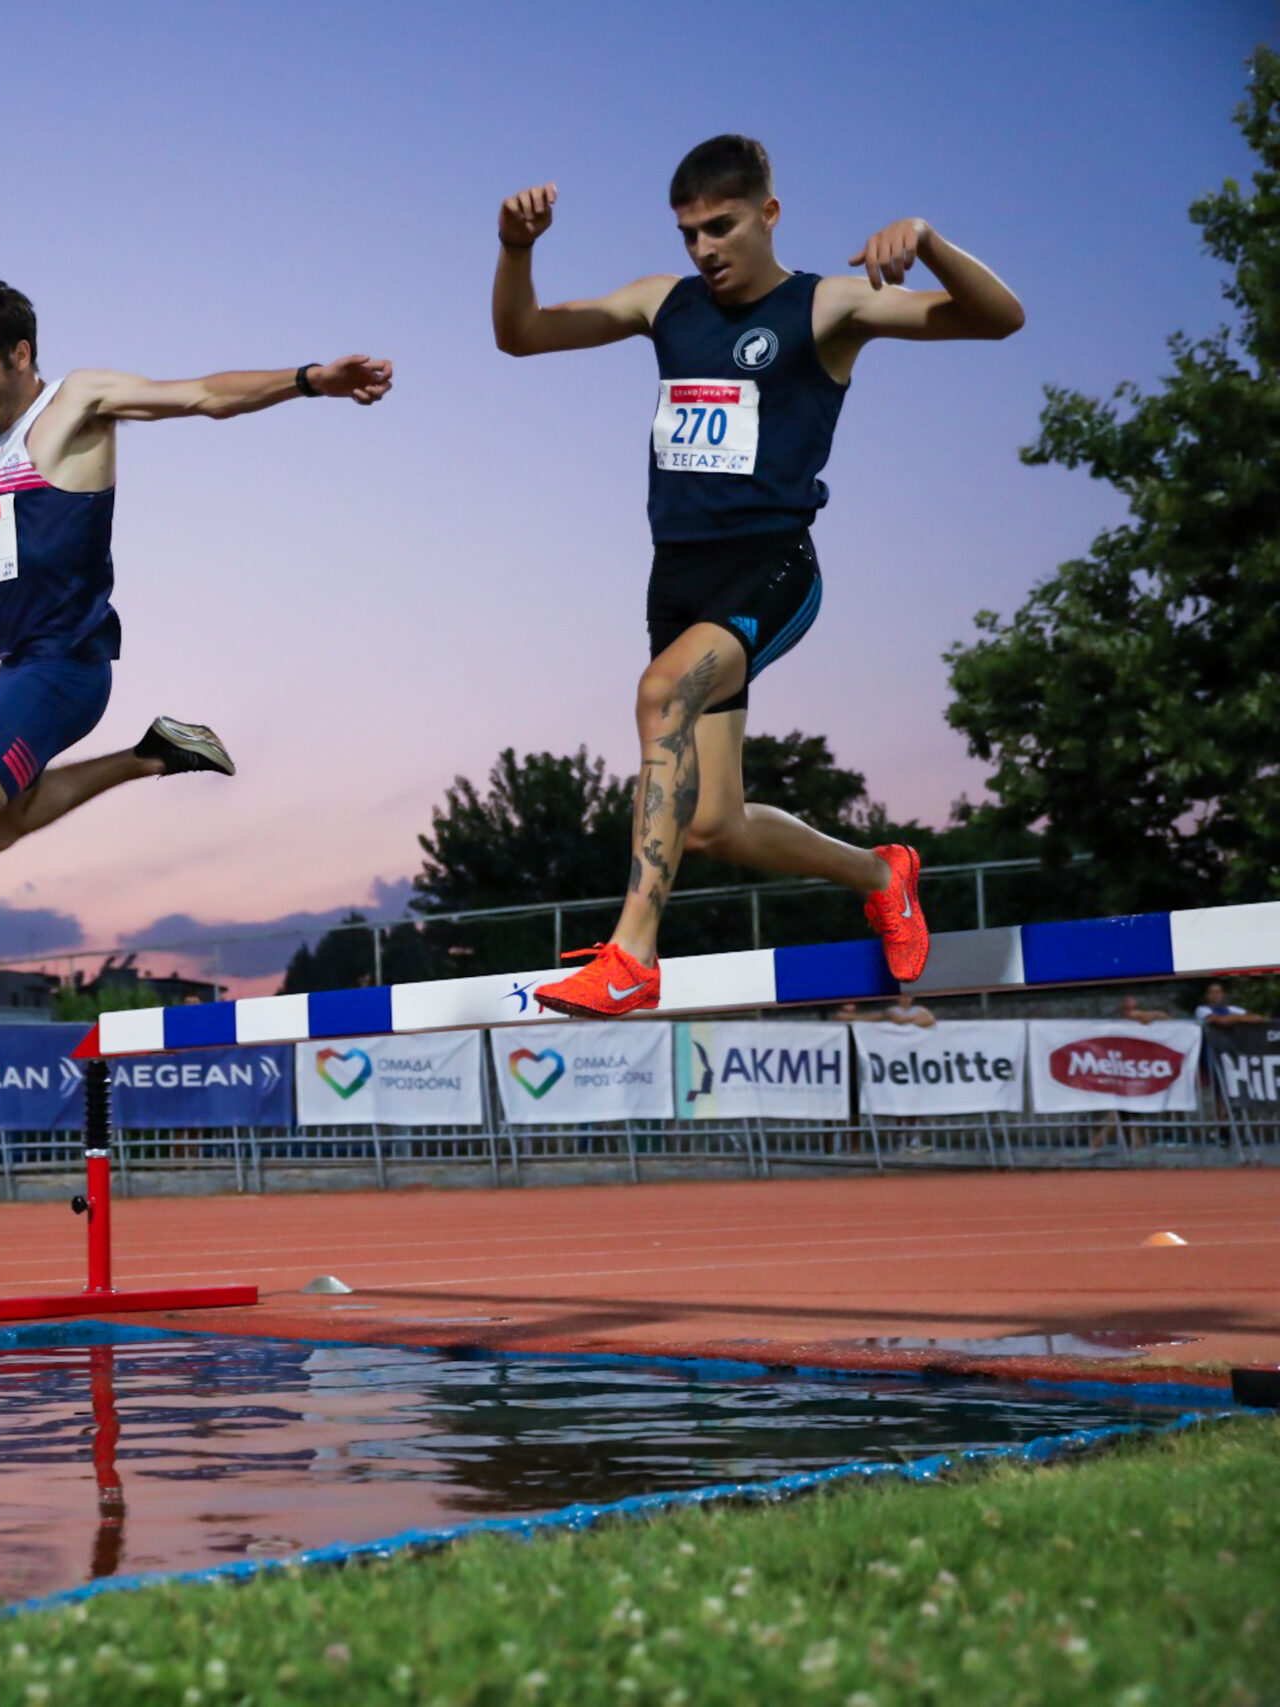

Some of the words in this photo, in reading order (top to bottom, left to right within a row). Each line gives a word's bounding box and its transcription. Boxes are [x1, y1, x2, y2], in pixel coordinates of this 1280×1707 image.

[670, 408, 727, 445] 270
[672, 452, 722, 468] ΣΕΓΑΣ
[112, 1063, 253, 1088] AEGEAN
[377, 1058, 433, 1071] ΟΜΑΔΑ
[721, 1047, 841, 1085] ΑΚΜΗ
[868, 1050, 1015, 1085] Deloitte
[1067, 1049, 1173, 1079] Melissa
